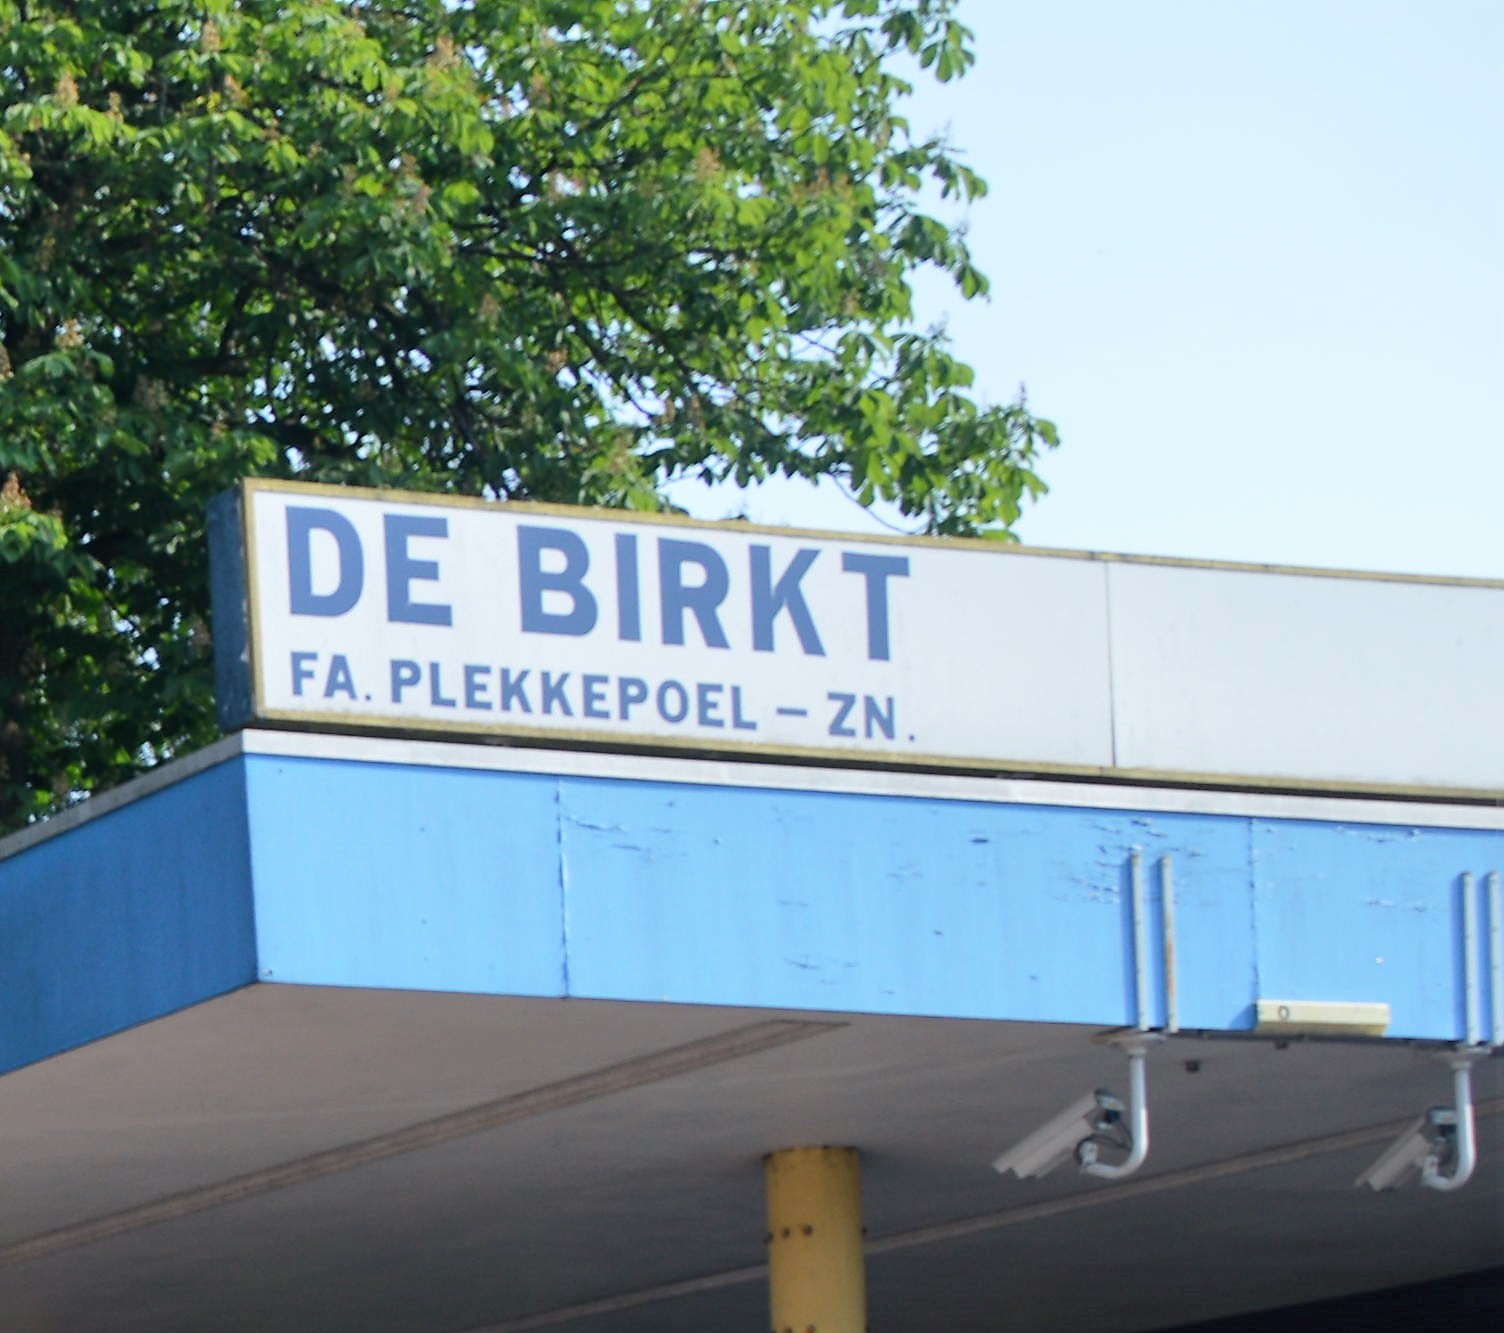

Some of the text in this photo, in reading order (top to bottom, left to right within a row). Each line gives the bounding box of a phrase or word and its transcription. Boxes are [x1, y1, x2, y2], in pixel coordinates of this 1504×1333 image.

[285, 504, 910, 662] DE BIRKT
[290, 651, 372, 702] FA.
[390, 658, 758, 731] PLEKKEPOEL
[826, 691, 917, 743] ZN.
